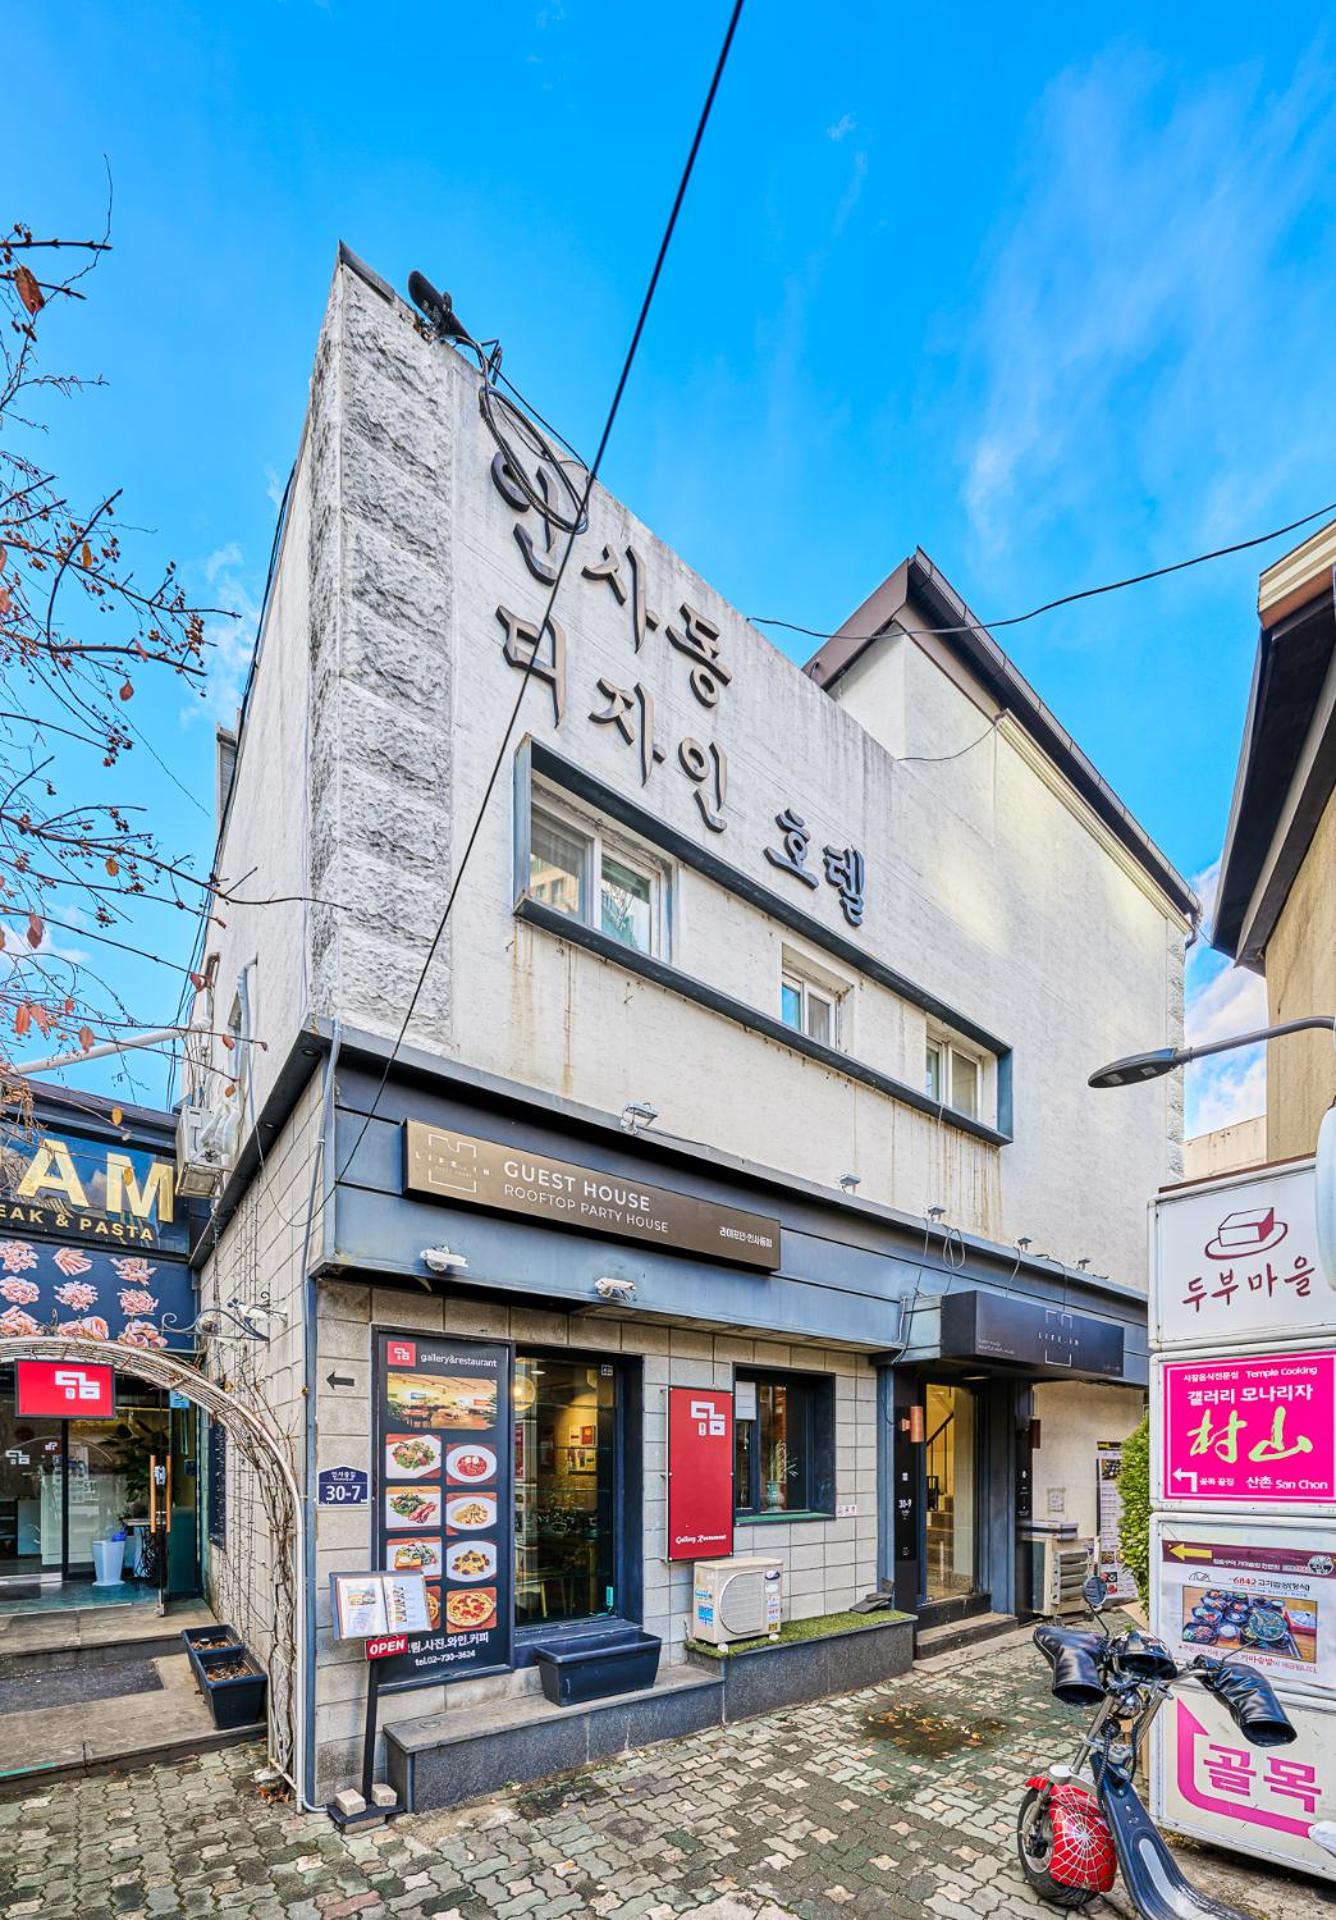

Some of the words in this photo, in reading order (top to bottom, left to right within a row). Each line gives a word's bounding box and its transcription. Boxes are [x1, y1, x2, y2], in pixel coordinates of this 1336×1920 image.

[490, 451, 732, 708] 인사동
[496, 604, 728, 833] 디자인
[763, 809, 865, 927] 호텔
[504, 1160, 576, 1192] GUEST
[584, 1180, 650, 1211] HOUSE
[56, 1214, 69, 1228] &
[80, 1218, 153, 1241] PASTA
[504, 1184, 576, 1209] ROOFTOP
[581, 1203, 623, 1222] PARTY
[626, 1213, 668, 1233] HOUSE
[1182, 1256, 1316, 1313] 두부마을
[1245, 1369, 1279, 1379] Temple
[1280, 1366, 1318, 1376] Cooking
[1187, 1388, 1236, 1406] 갤러리
[1240, 1383, 1314, 1402] 모나리자
[325, 1485, 361, 1501] 30-7
[1245, 1475, 1273, 1489] 산촌
[1275, 1479, 1296, 1490] San
[1298, 1479, 1328, 1490] Chon
[369, 1638, 405, 1656] OPEN
[1203, 1743, 1322, 1813] 골목
